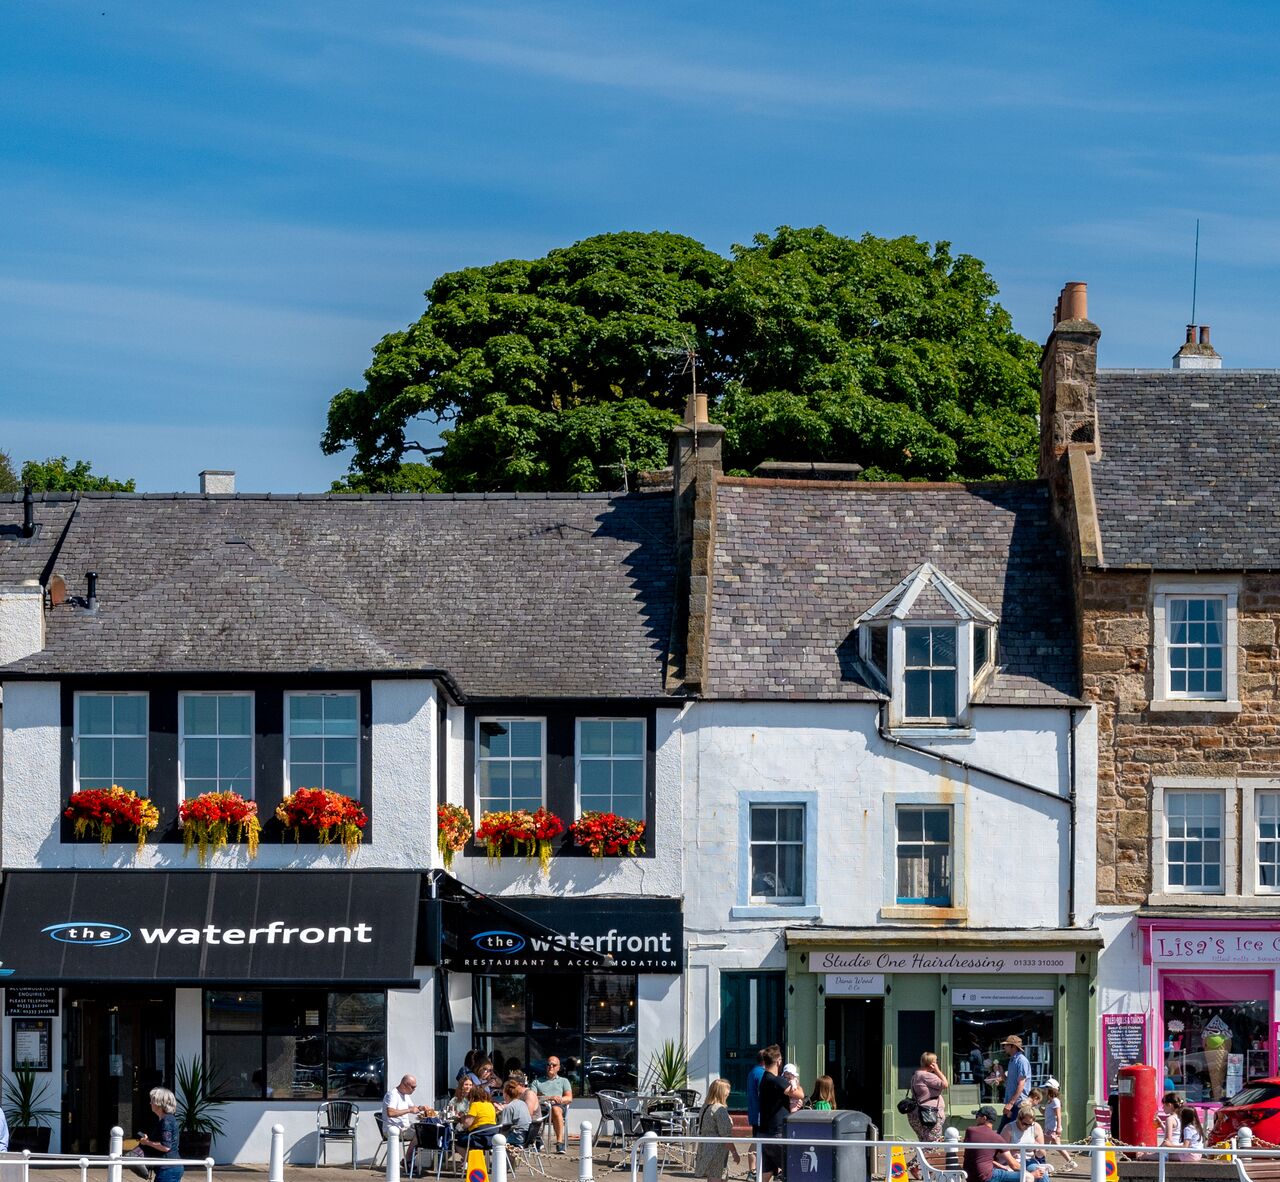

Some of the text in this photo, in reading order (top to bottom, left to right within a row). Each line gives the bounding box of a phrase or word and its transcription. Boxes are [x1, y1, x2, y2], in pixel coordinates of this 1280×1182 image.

[69, 921, 373, 945] the waterfront
[487, 937, 514, 947] the
[1157, 936, 1225, 957] Lisa's
[1235, 937, 1263, 951] Ice
[822, 952, 872, 968] Studio
[876, 952, 908, 968] One
[910, 952, 1006, 972] Hairdressing
